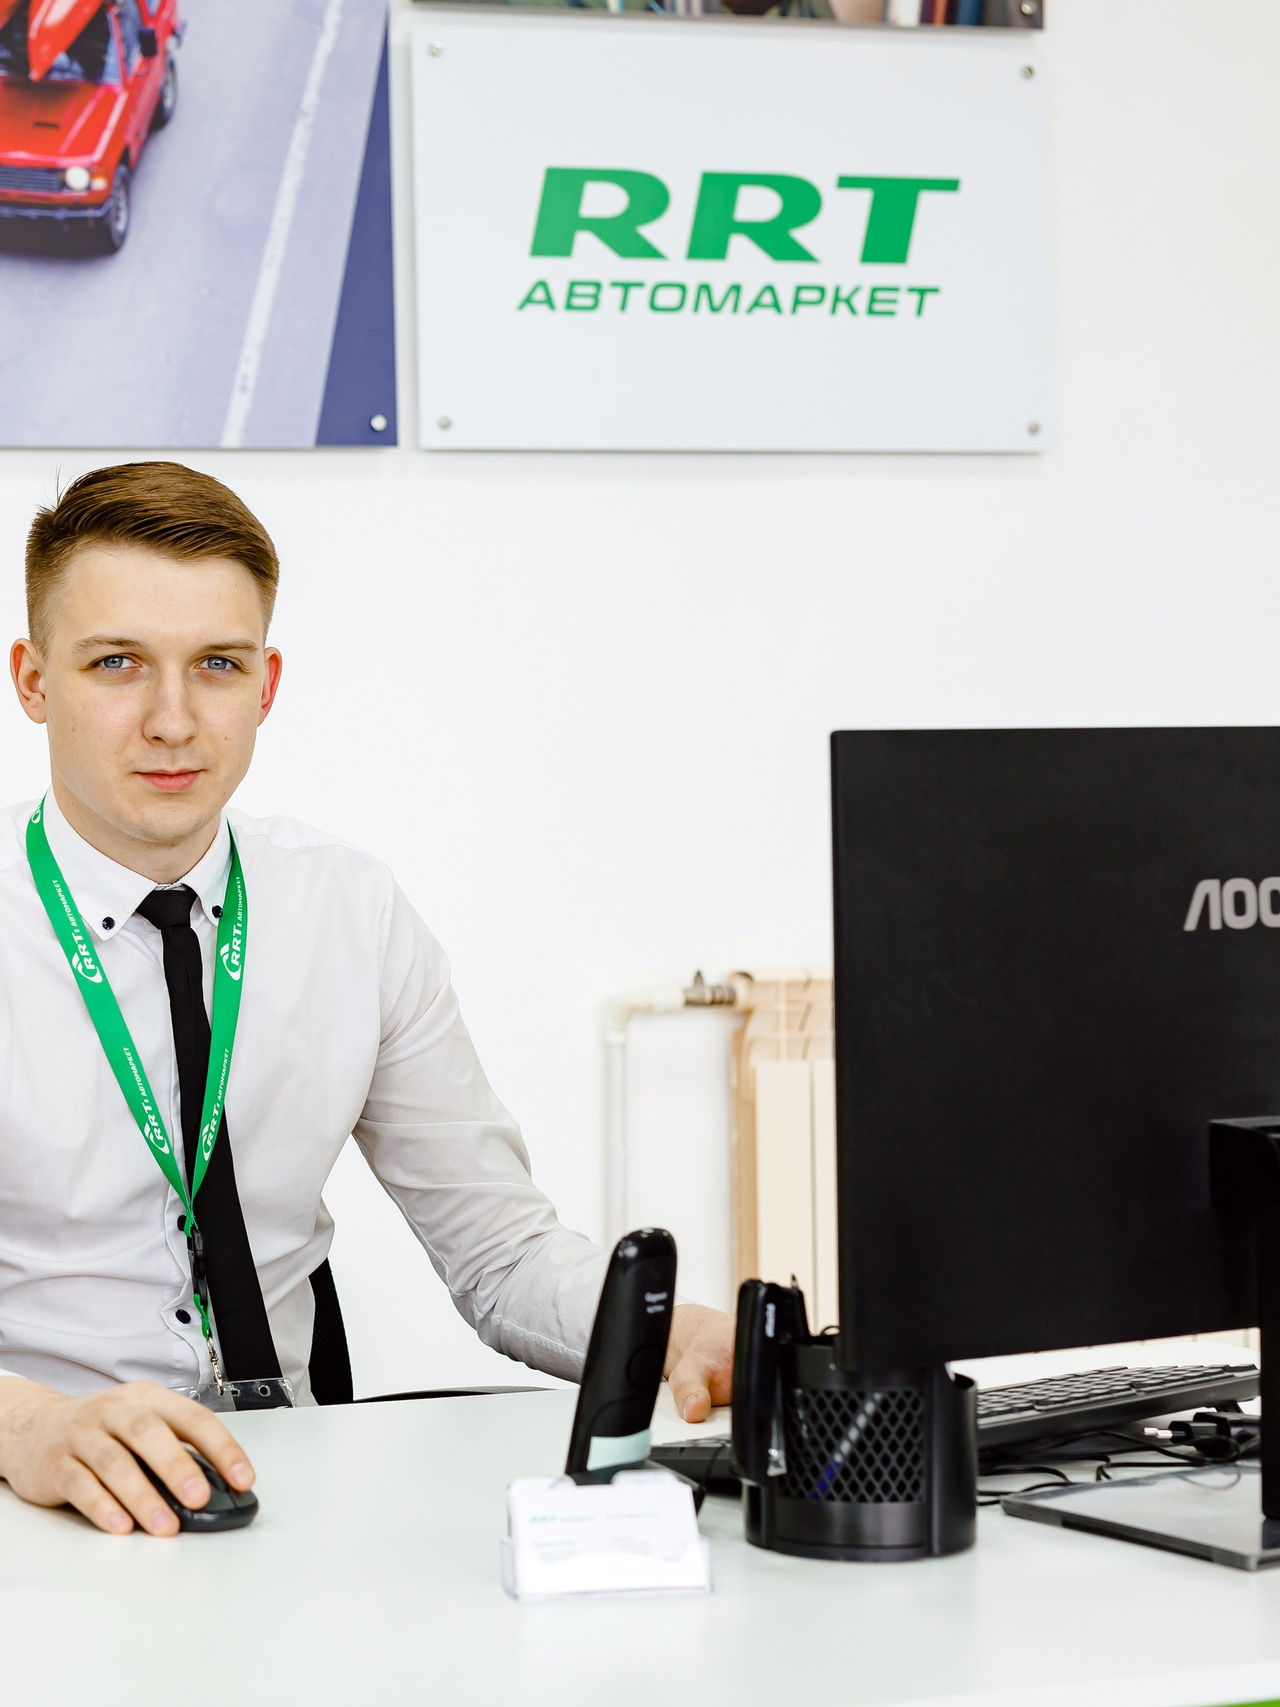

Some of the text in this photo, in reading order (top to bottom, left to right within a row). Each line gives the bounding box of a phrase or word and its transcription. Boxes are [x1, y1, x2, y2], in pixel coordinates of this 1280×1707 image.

[530, 167, 960, 264] RRT
[517, 279, 940, 317] АВТОМАРКЕТ
[71, 932, 96, 970] RRT
[230, 924, 242, 967] RRT
[141, 1102, 164, 1140] RRT
[206, 1103, 219, 1147] RRT
